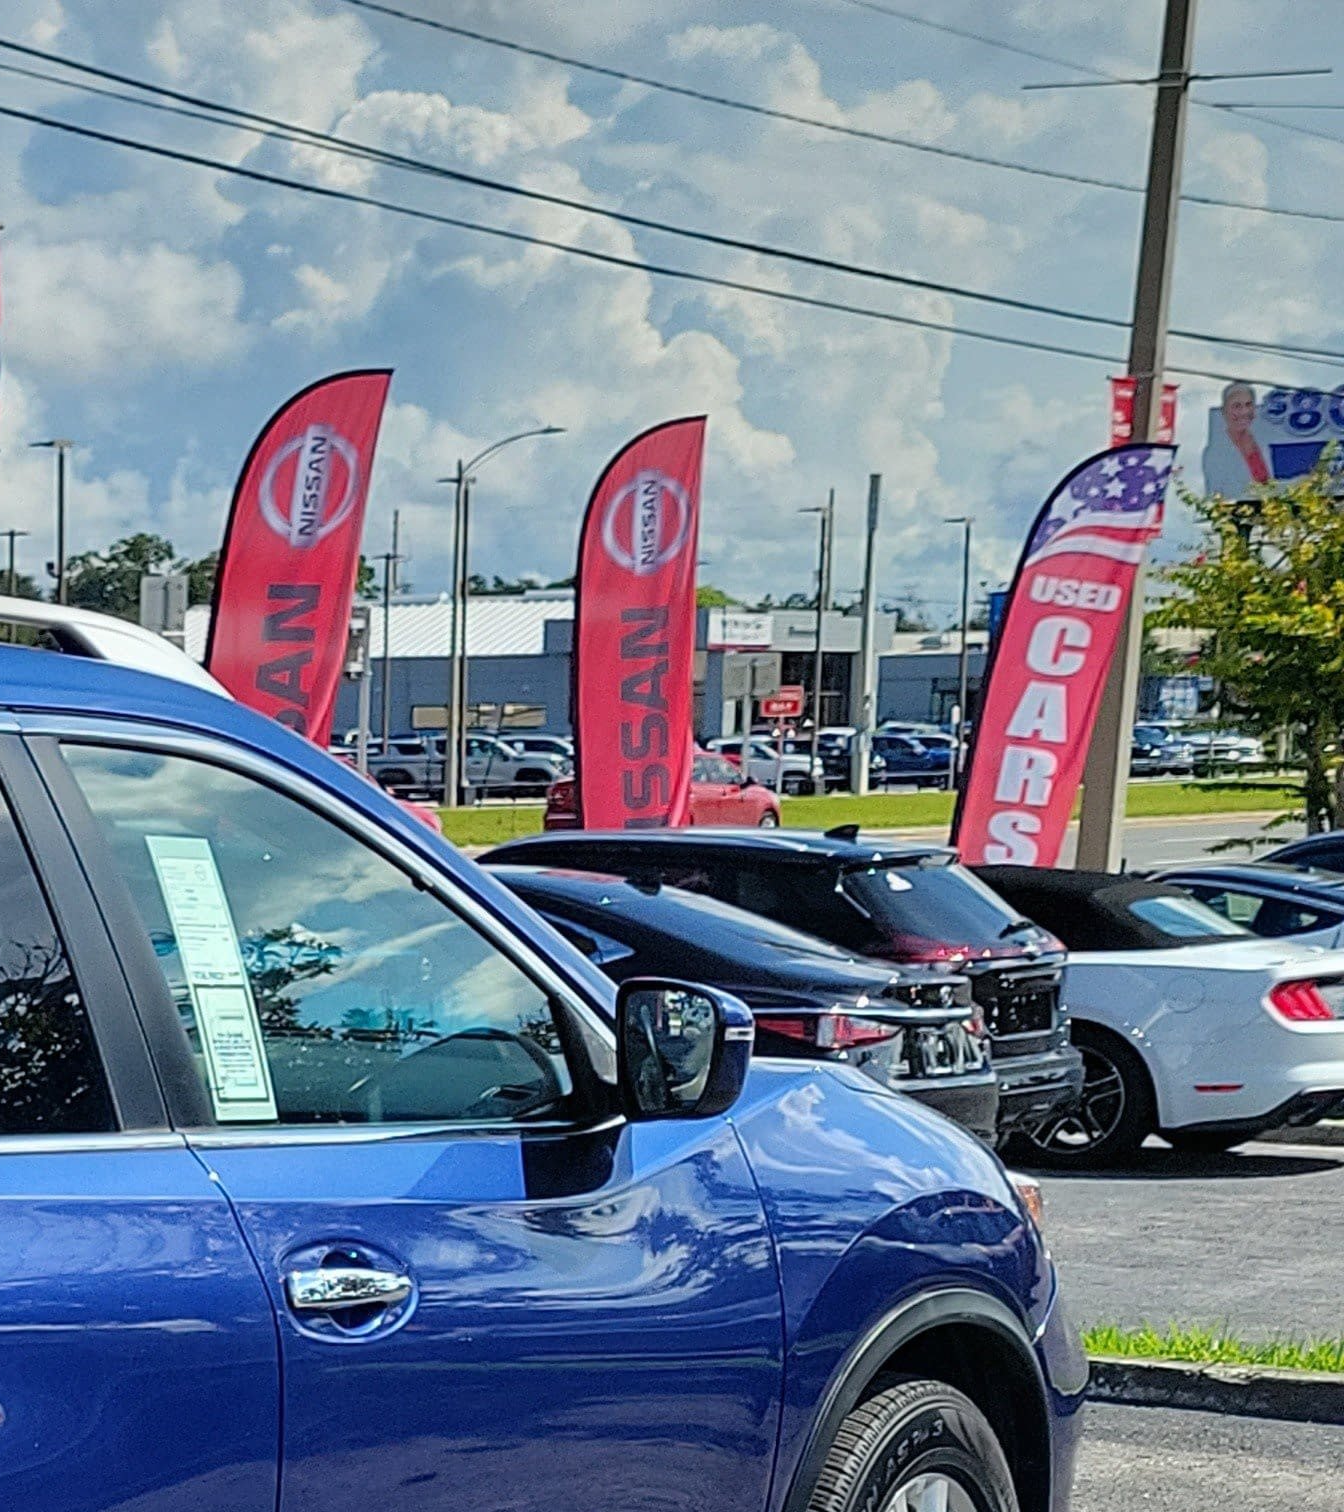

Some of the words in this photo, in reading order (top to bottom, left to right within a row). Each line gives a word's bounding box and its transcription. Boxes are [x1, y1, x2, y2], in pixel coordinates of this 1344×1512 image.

[298, 435, 328, 538] NISSAN
[639, 479, 659, 568] NISSAN
[1029, 574, 1122, 613] USED
[618, 606, 671, 829] ISSAN
[983, 616, 1092, 865] CARS
